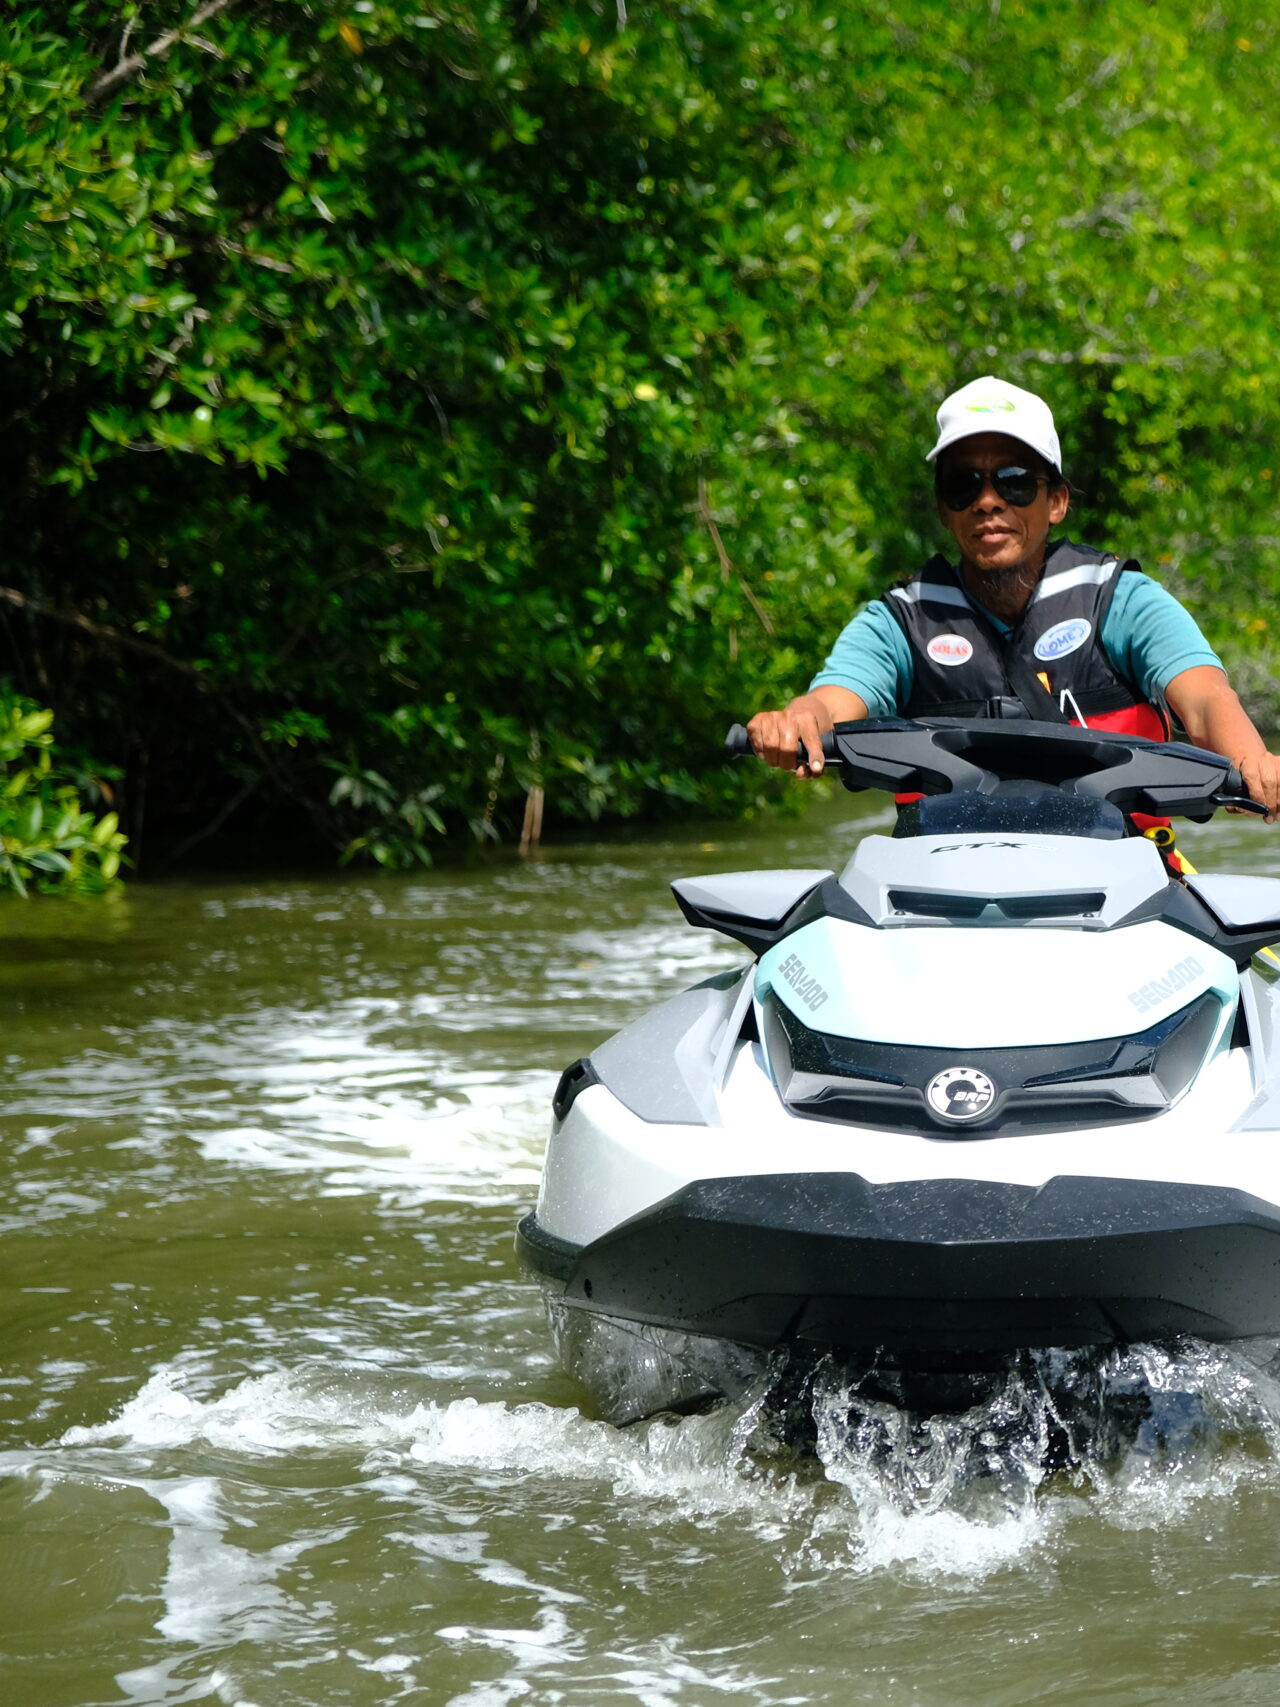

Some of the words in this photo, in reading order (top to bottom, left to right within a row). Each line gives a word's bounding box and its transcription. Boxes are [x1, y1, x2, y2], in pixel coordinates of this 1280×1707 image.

[931, 643, 968, 657] SOLAS
[930, 842, 1028, 854] GTX
[953, 1091, 991, 1103] BRP
